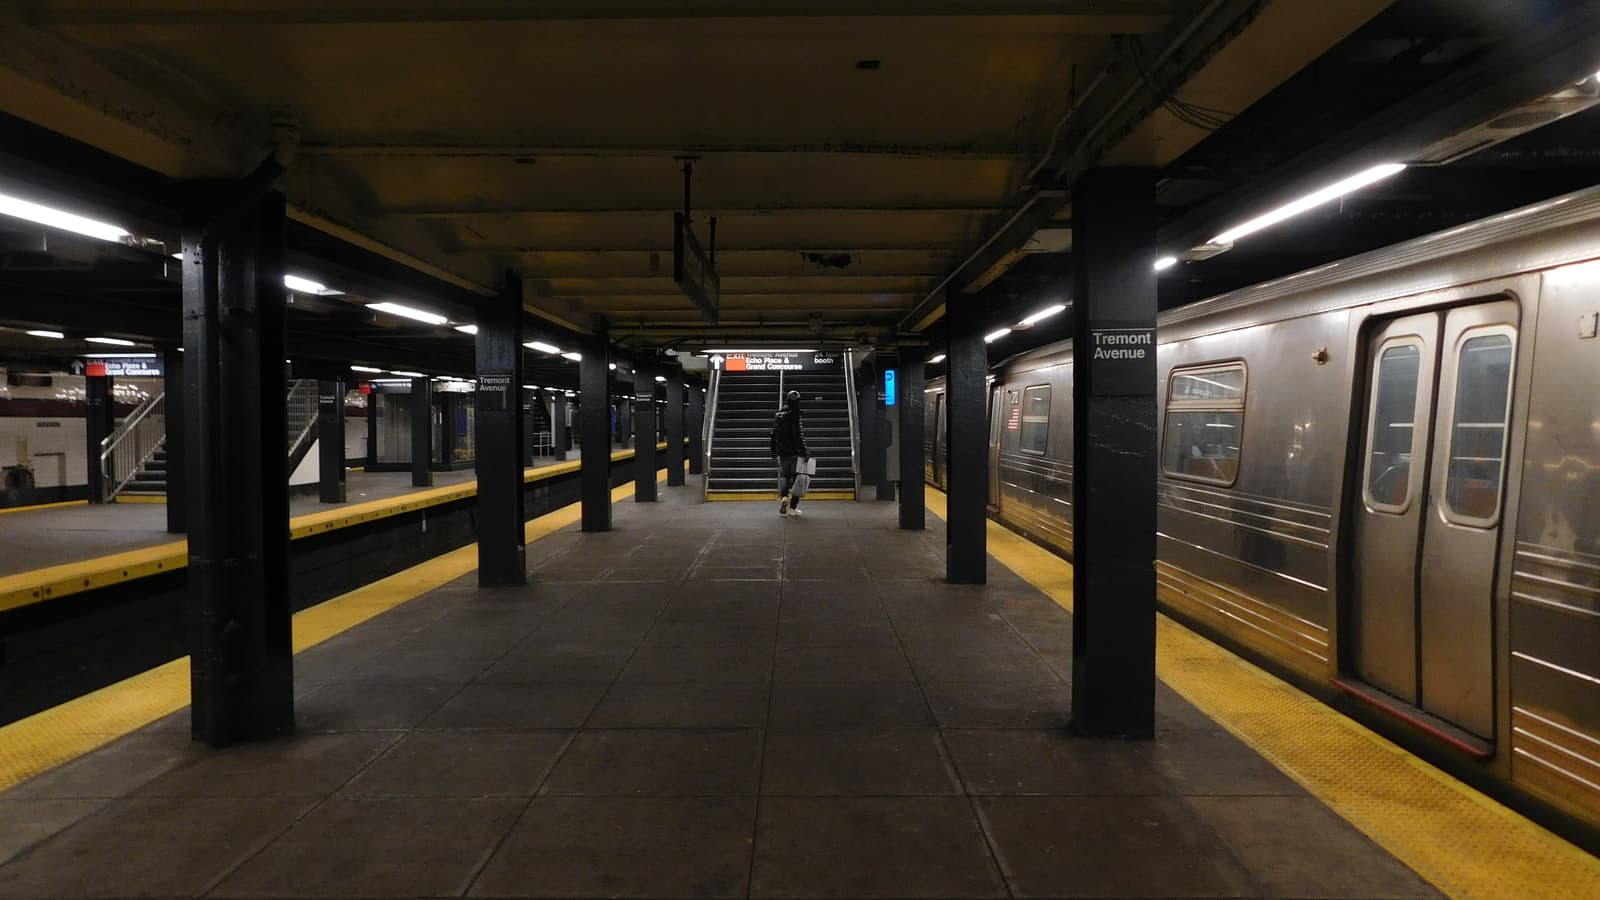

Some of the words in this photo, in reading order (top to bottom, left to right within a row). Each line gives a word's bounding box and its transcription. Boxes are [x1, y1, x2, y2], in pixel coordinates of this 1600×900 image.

[1092, 332, 1152, 345] Tremont
[1093, 347, 1145, 359] Avenue
[479, 376, 510, 384] Tremont
